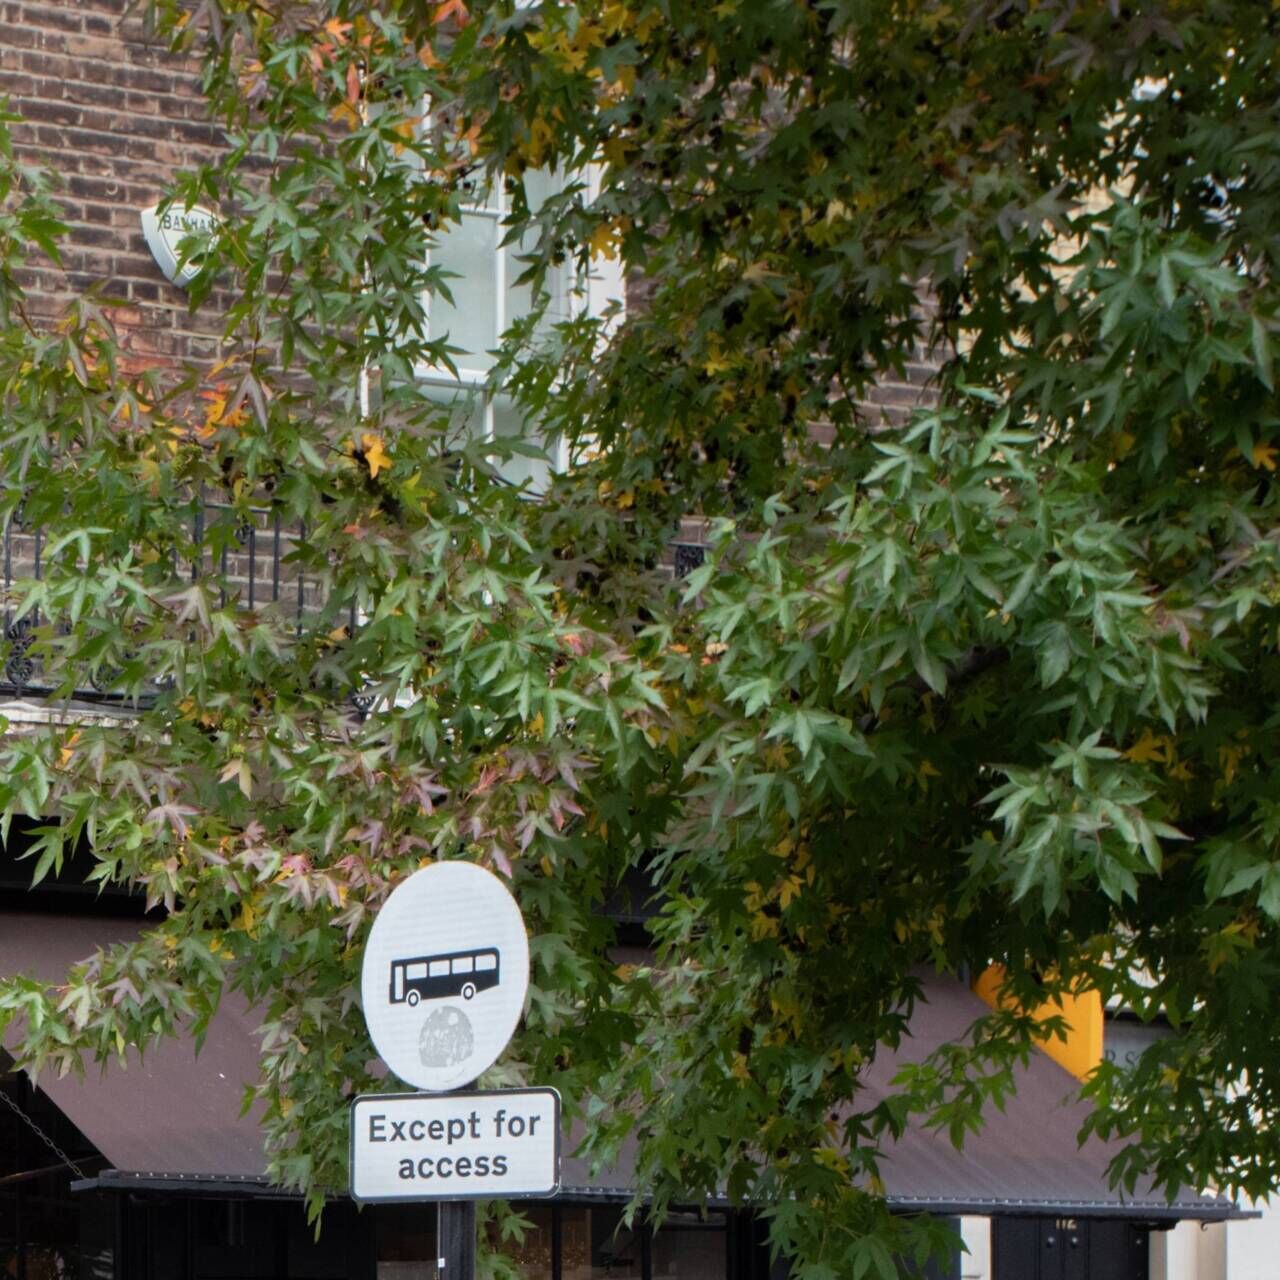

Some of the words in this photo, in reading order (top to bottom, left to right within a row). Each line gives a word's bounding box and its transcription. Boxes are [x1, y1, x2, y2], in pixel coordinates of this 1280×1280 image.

[368, 1110, 481, 1145] Except
[493, 1109, 541, 1138] for
[398, 1154, 508, 1180] access
